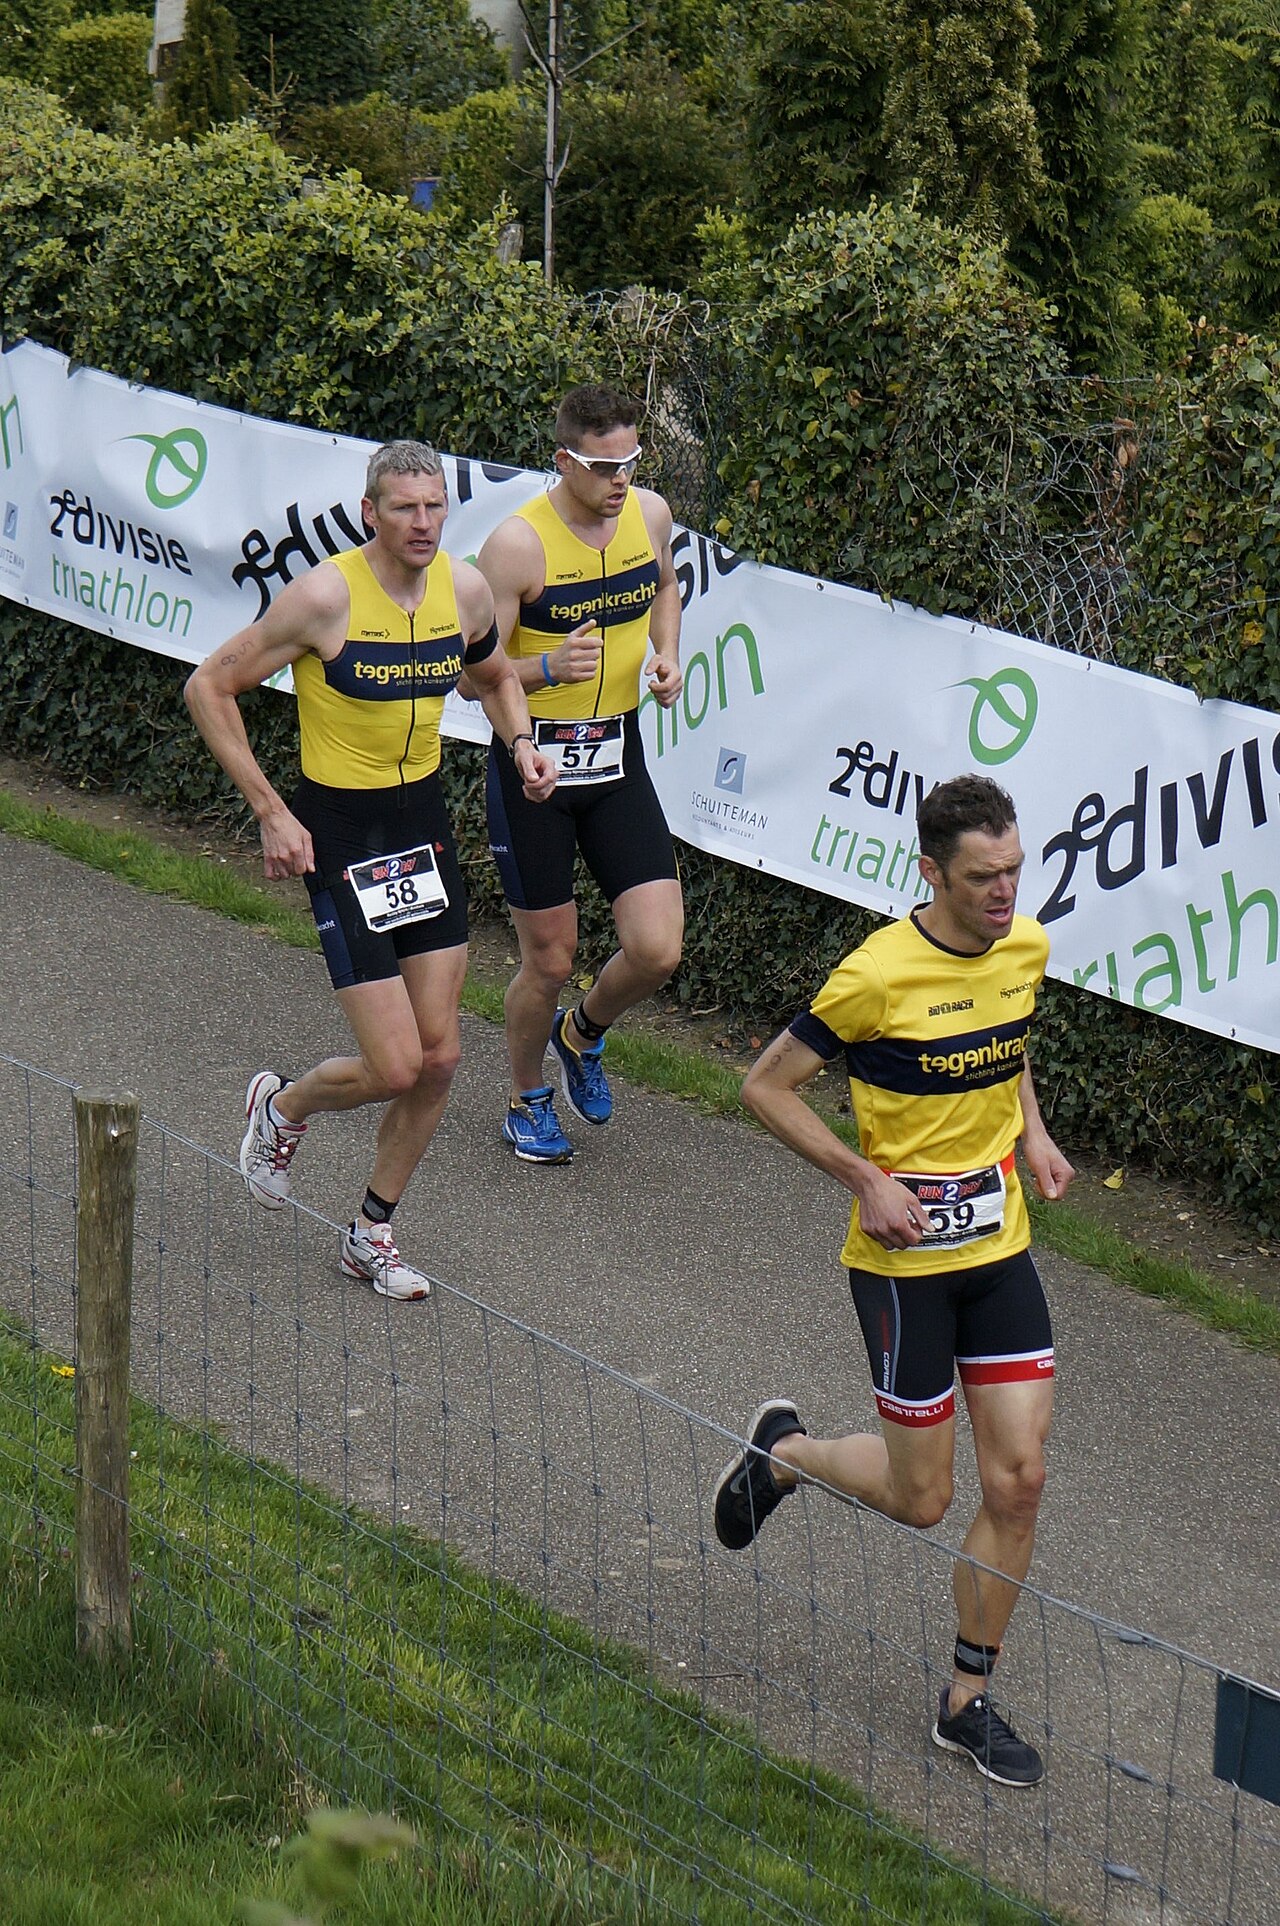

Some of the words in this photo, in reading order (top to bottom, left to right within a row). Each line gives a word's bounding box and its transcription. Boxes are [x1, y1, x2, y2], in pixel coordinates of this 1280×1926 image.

[52, 553, 193, 637] triathlon
[550, 581, 657, 622] tegenkracht
[353, 654, 462, 685] tegenkracht
[562, 744, 602, 768] 57
[829, 741, 940, 821] 2ediv
[691, 791, 768, 829] SCHUITEMAN
[1036, 731, 1280, 926] 2edivi
[811, 814, 933, 901] triath
[385, 878, 419, 909] 58
[918, 1025, 1031, 1077] tegenkrac
[928, 1202, 974, 1233] 59
